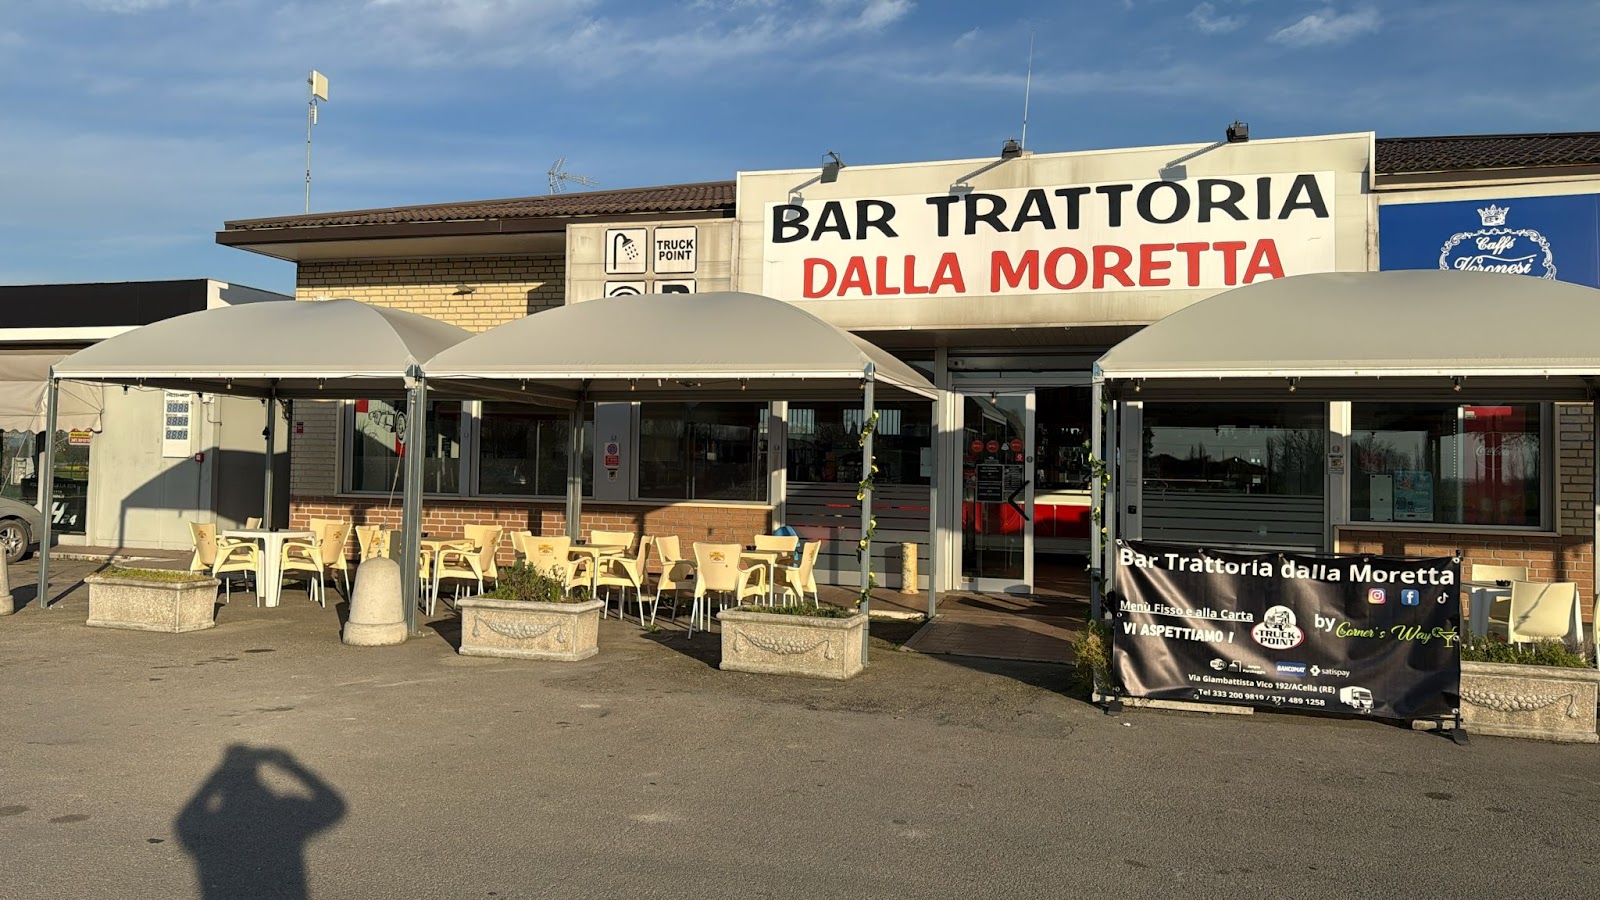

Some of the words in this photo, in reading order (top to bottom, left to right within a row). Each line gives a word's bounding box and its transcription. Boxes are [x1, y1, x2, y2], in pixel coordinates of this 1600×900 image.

[772, 200, 898, 243] BAR
[926, 174, 1330, 238] TRATTORIA
[657, 239, 693, 250] TRUCK
[659, 251, 691, 260] POINT
[802, 252, 966, 298] DALLA
[990, 239, 1284, 293] MORETTA
[1120, 548, 1158, 569] Bar
[1164, 553, 1273, 577] Trattoria
[1281, 560, 1341, 581] dalla
[1350, 564, 1454, 585] Moretta
[1120, 600, 1150, 612] Menù
[1154, 603, 1183, 615] Fisso
[1186, 607, 1193, 616] e
[1195, 607, 1217, 619] alla
[1220, 609, 1254, 621] Carta
[1123, 622, 1137, 635] VI
[1140, 625, 1224, 643] ASPETTIAMO
[1258, 629, 1295, 640] TRUCK
[1314, 613, 1336, 632] by
[1336, 622, 1386, 639] Corner's
[1391, 625, 1432, 645] Way
[1260, 637, 1295, 646] POINT
[1276, 664, 1306, 673] BANCOMAT
[1321, 667, 1350, 677] satispay
[1188, 674, 1201, 682] Via
[1203, 675, 1254, 687] Giambattista
[1256, 680, 1273, 689] Vico
[1319, 686, 1336, 695] (RE)
[1198, 688, 1211, 697] Tel
[1213, 690, 1227, 698] 333
[1229, 691, 1243, 699] 200
[1306, 698, 1326, 706] 1258
